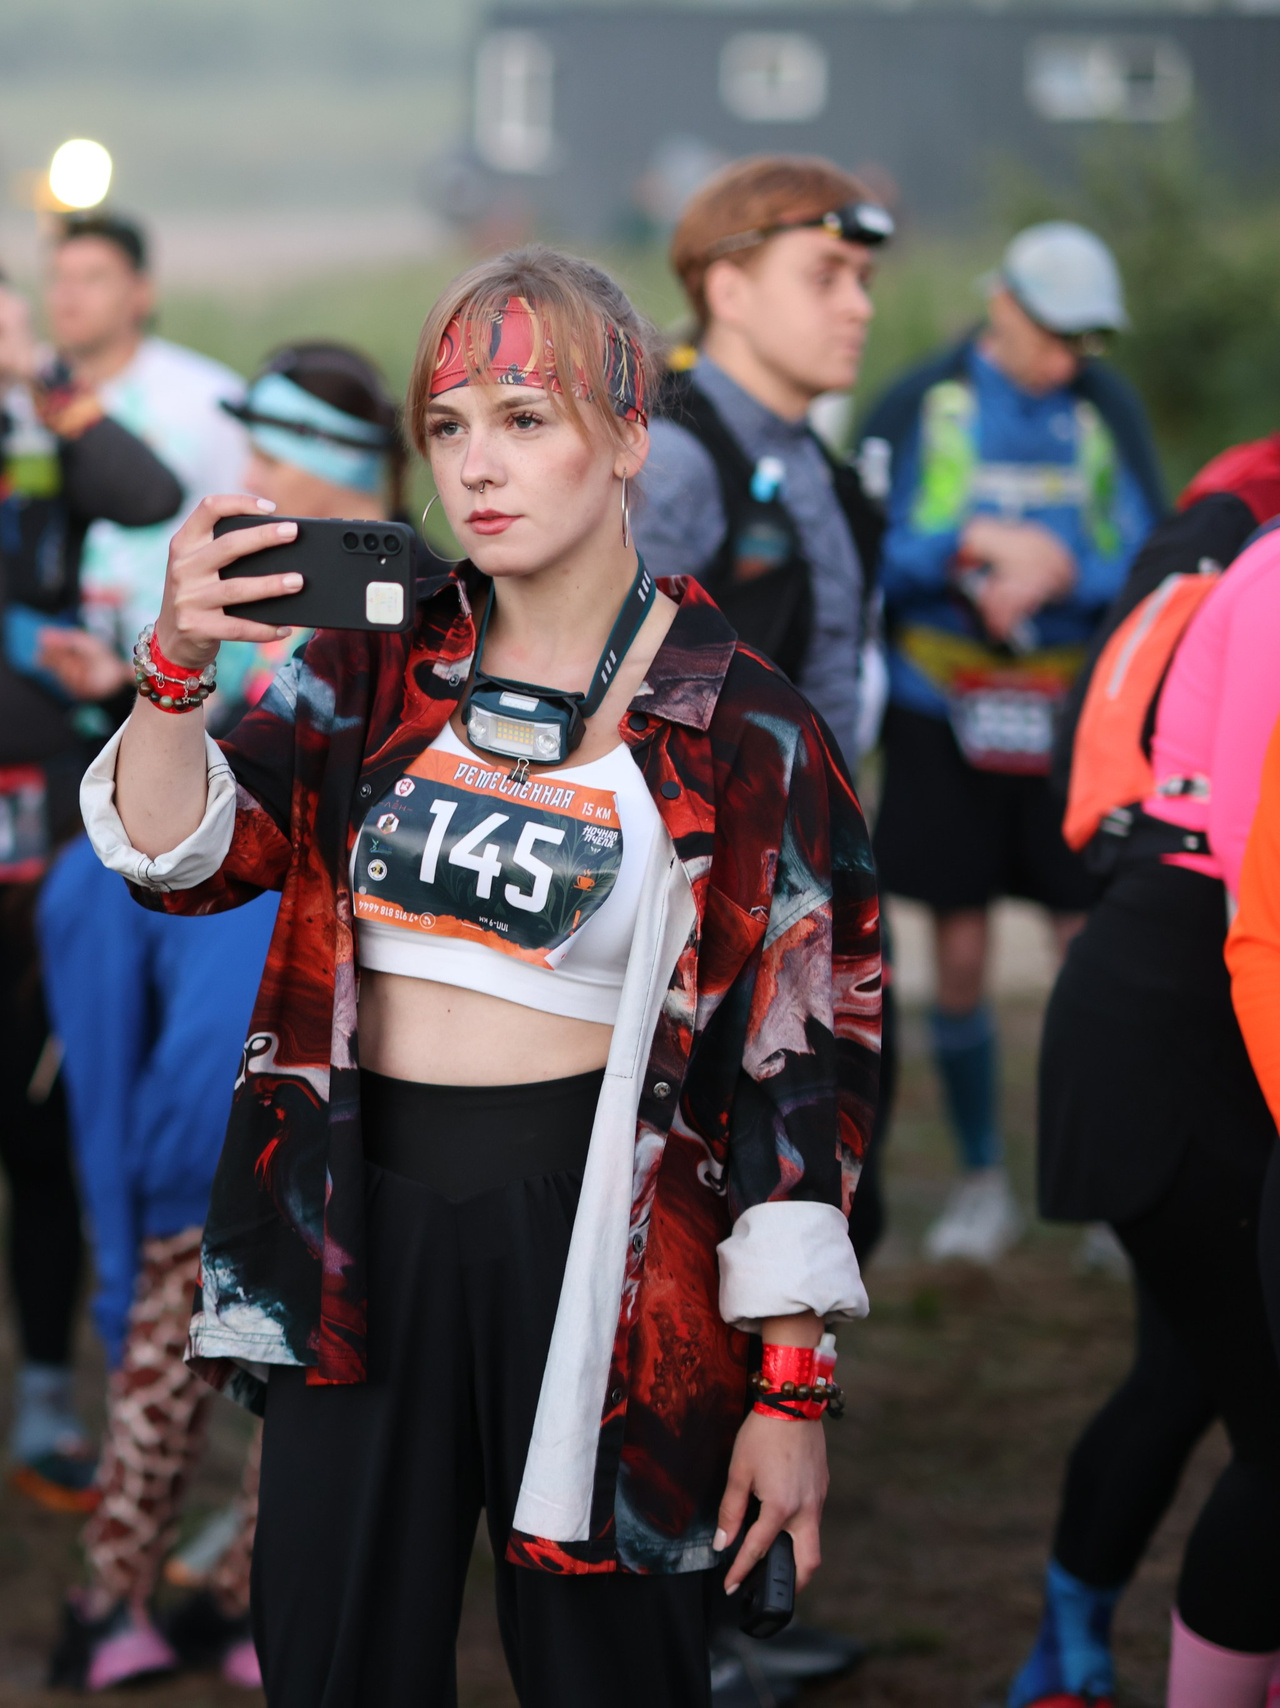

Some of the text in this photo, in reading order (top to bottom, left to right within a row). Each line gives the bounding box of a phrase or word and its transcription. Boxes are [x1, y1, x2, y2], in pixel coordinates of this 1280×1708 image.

[453, 762, 576, 809] РЕМЕСЛЕННАЯ
[582, 802, 595, 816] 15
[582, 824, 619, 841] НОЧНАЯ
[584, 833, 615, 849] ПЧЕЛА
[420, 799, 566, 913] 145
[358, 900, 379, 913] 4644
[380, 905, 394, 917] 818
[395, 911, 408, 921] 915
